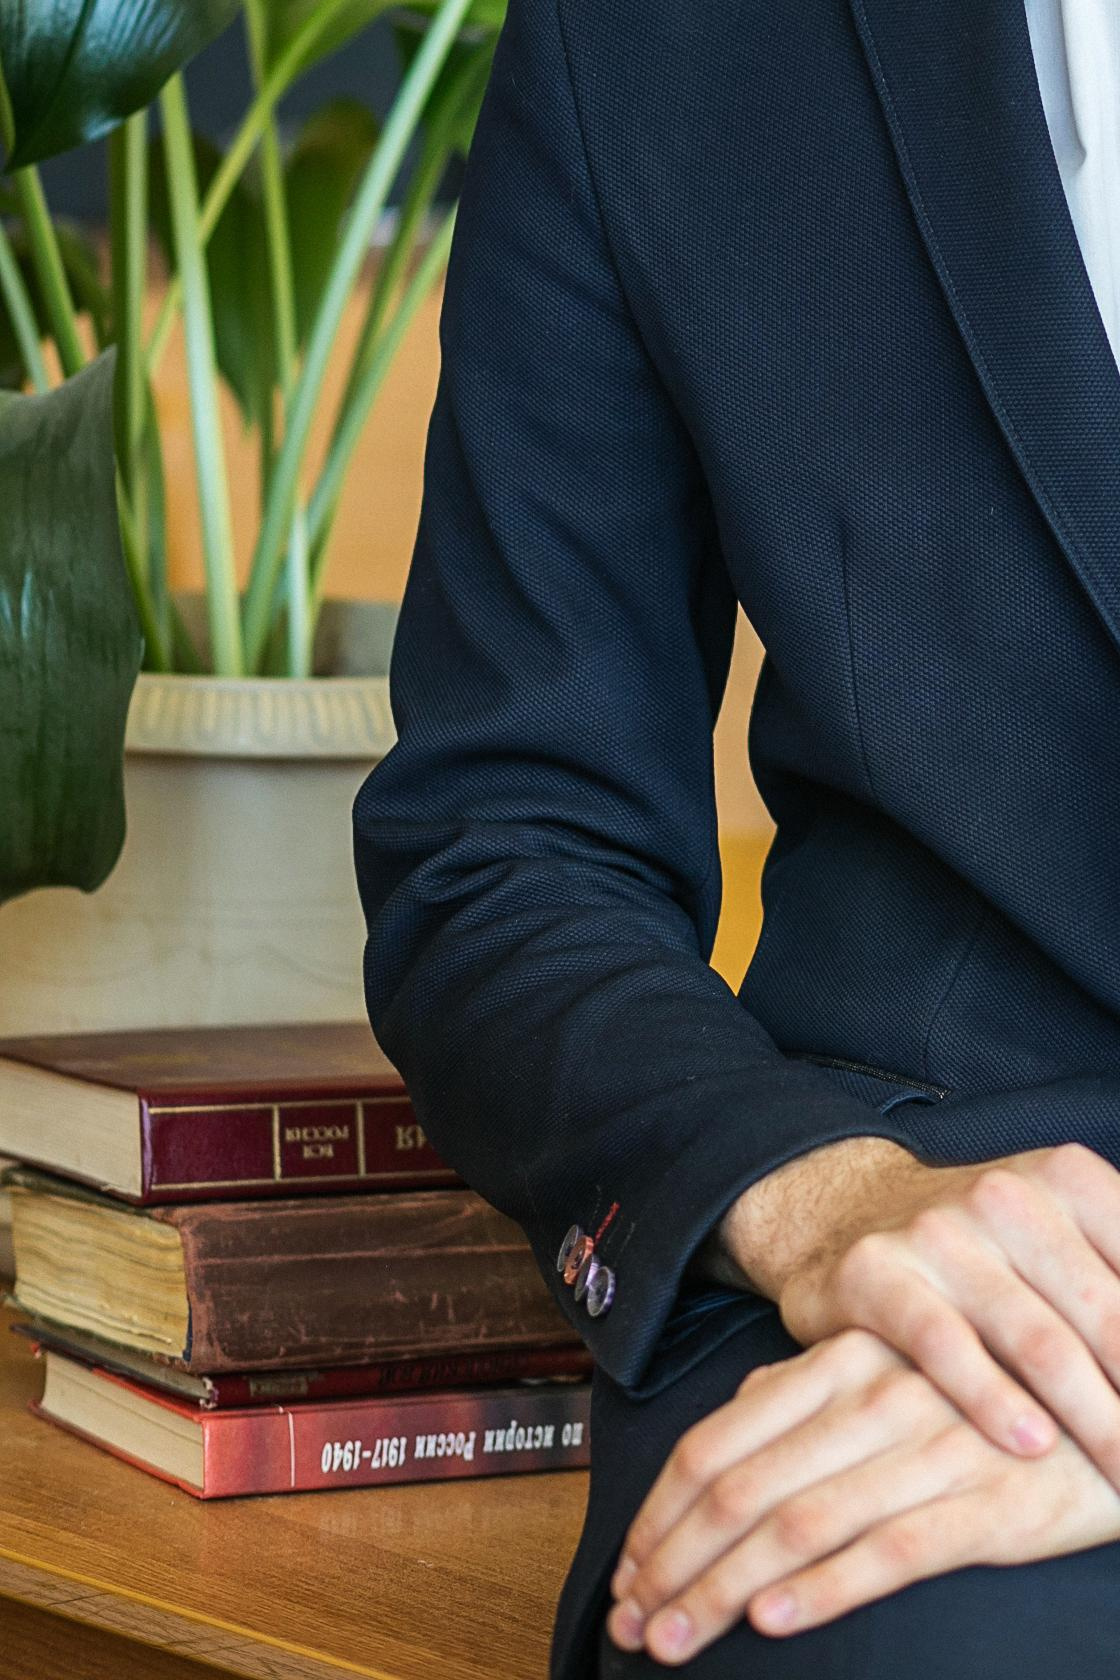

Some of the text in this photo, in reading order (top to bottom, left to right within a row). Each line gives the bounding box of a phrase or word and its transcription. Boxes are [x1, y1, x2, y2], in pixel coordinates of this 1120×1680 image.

[285, 1125, 350, 1142] РОССИЯ
[321, 1420, 584, 1473] по истории России 1917-1940
